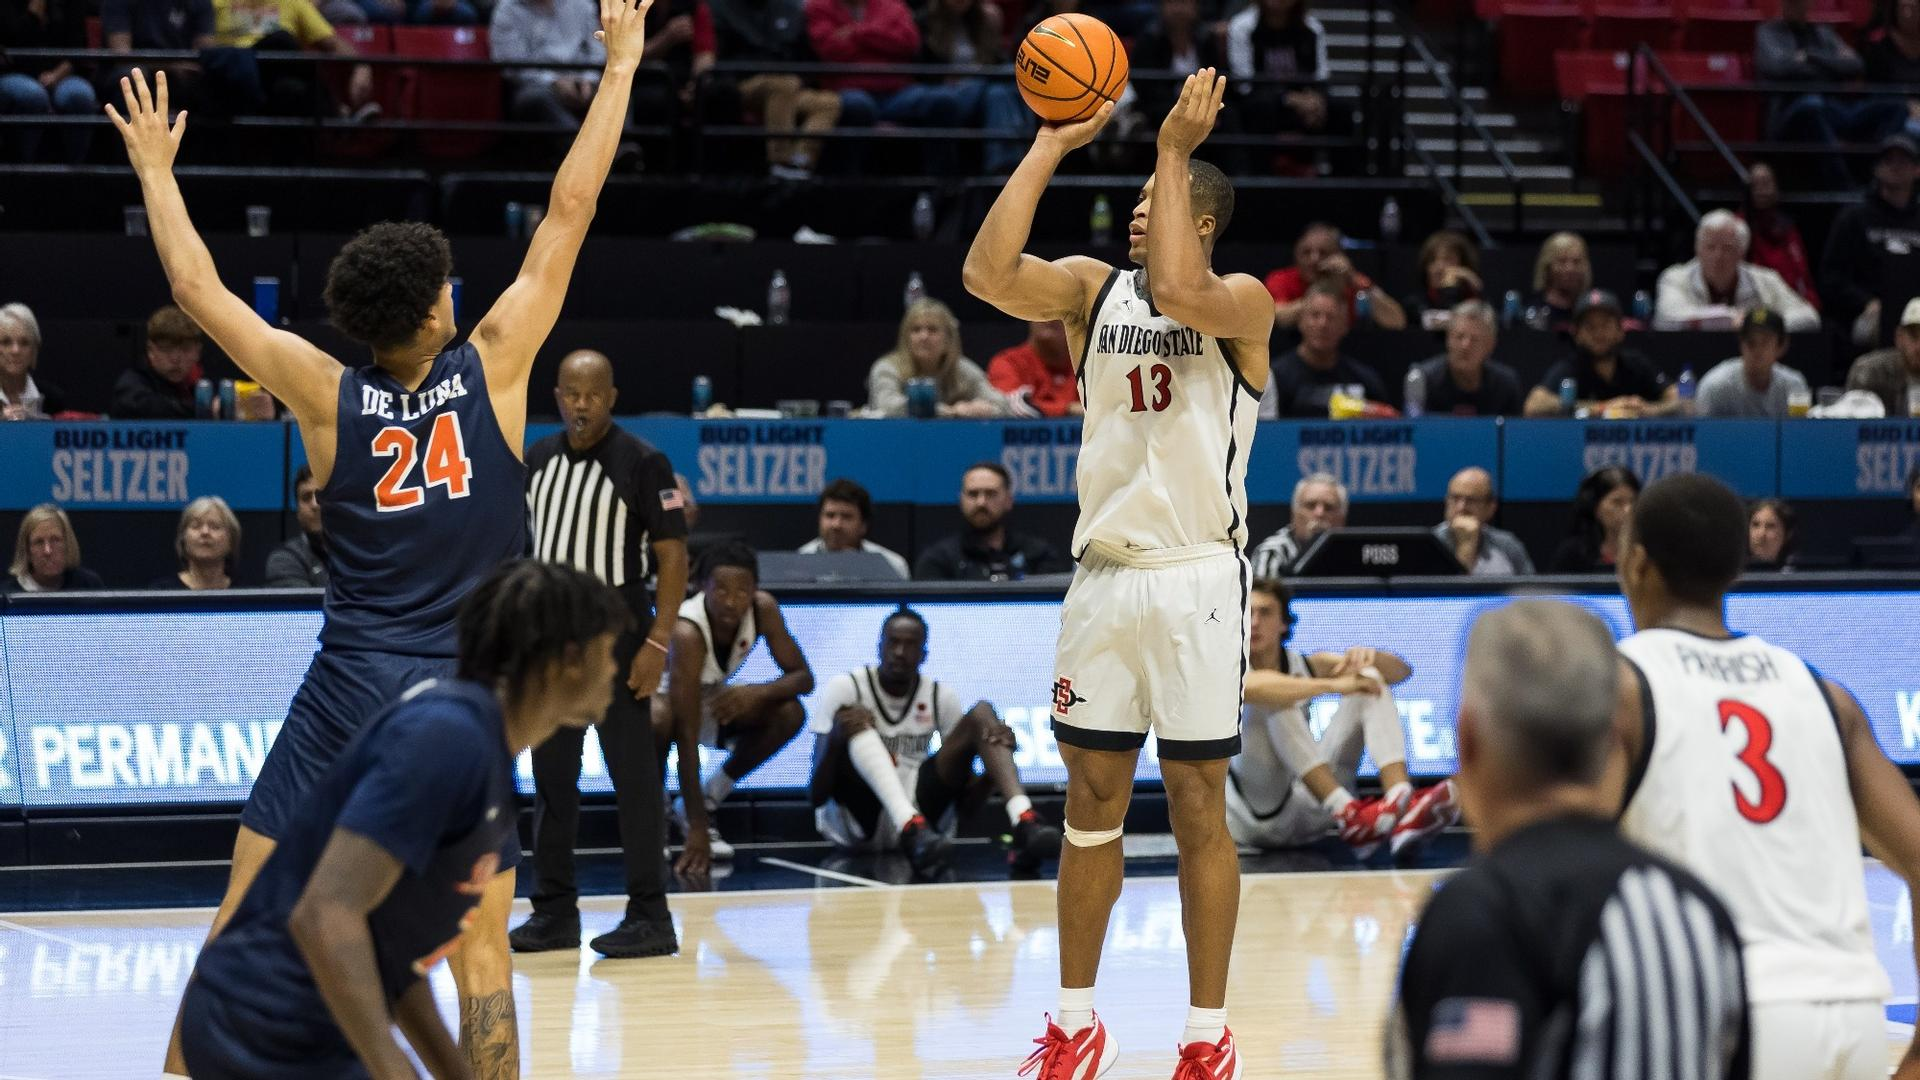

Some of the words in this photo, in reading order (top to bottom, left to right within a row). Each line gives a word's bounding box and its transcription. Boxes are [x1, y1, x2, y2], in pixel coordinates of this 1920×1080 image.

[1117, 324, 1162, 356] DIEGO
[1163, 326, 1204, 357] STATE
[361, 384, 395, 420] DE
[400, 373, 468, 421] LUNA
[1126, 364, 1172, 412] 13
[54, 428, 108, 449] BUD
[113, 428, 188, 449] LIGHT
[700, 424, 751, 446] BUD
[756, 423, 826, 446] LIGHT
[51, 448, 189, 501] SELTZER
[371, 410, 473, 512] 24
[697, 445, 827, 495] SELTZER
[1717, 698, 1788, 825] 3
